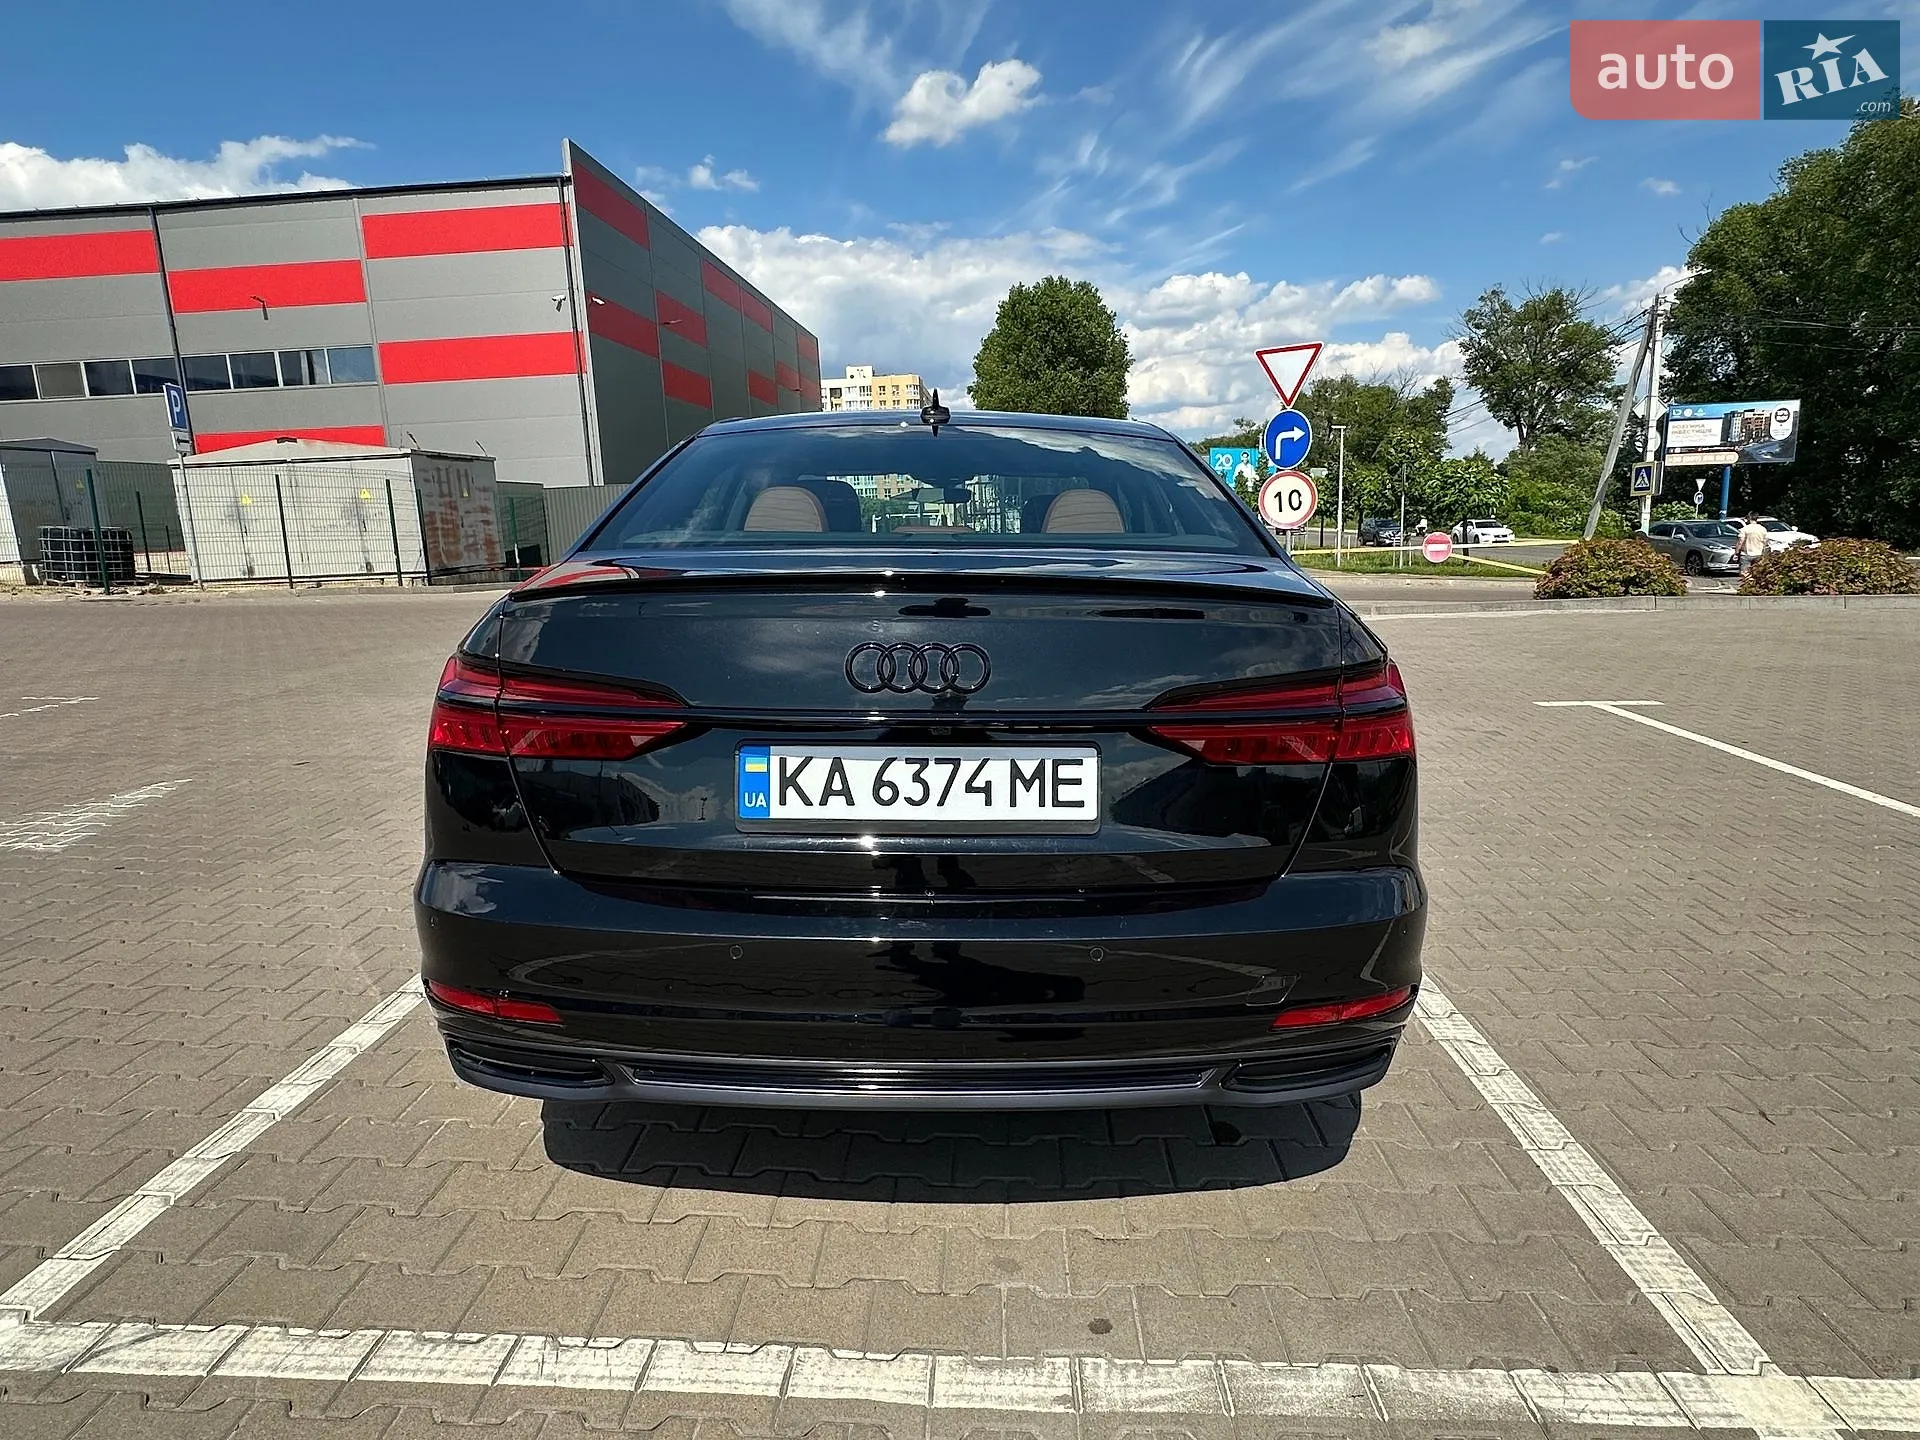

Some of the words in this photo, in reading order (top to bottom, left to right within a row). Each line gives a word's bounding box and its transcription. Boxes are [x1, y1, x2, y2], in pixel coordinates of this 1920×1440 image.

[170, 390, 181, 424] P
[1214, 453, 1233, 470] 20
[1274, 489, 1303, 513] 10
[778, 756, 856, 806] KA
[872, 756, 993, 807] 6374
[1009, 758, 1085, 808] ME
[744, 792, 767, 808] UA
